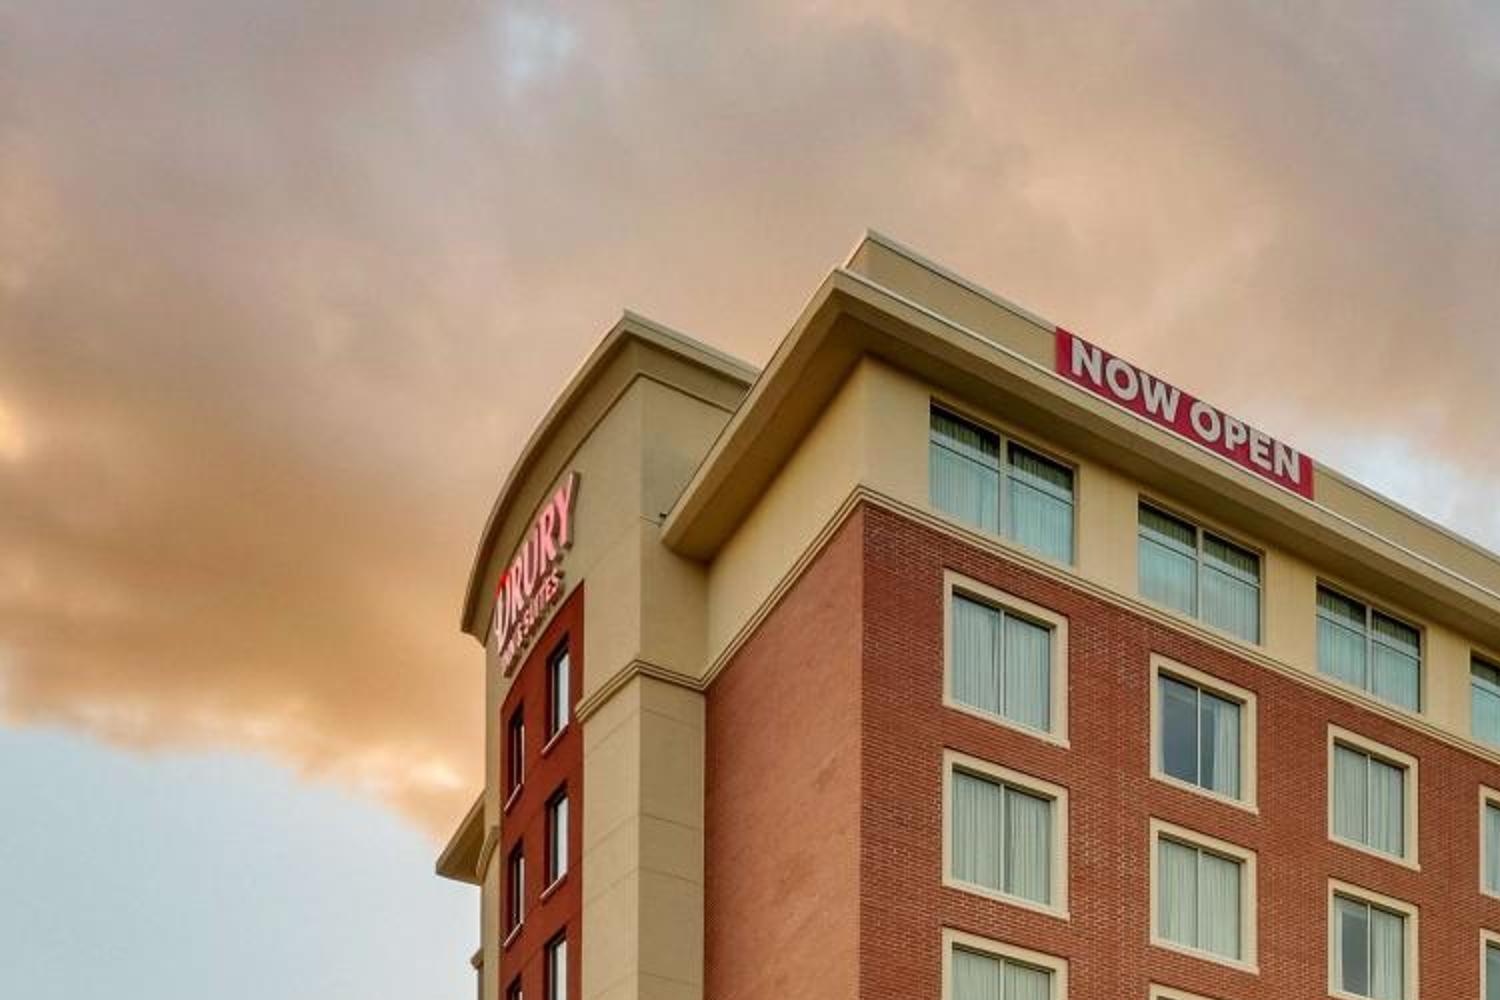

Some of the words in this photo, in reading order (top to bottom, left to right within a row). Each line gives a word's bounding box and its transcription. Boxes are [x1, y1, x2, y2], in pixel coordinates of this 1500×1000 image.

[1071, 337, 1181, 423] NOW
[1190, 400, 1301, 485] OPEN
[492, 472, 575, 656] DRURY
